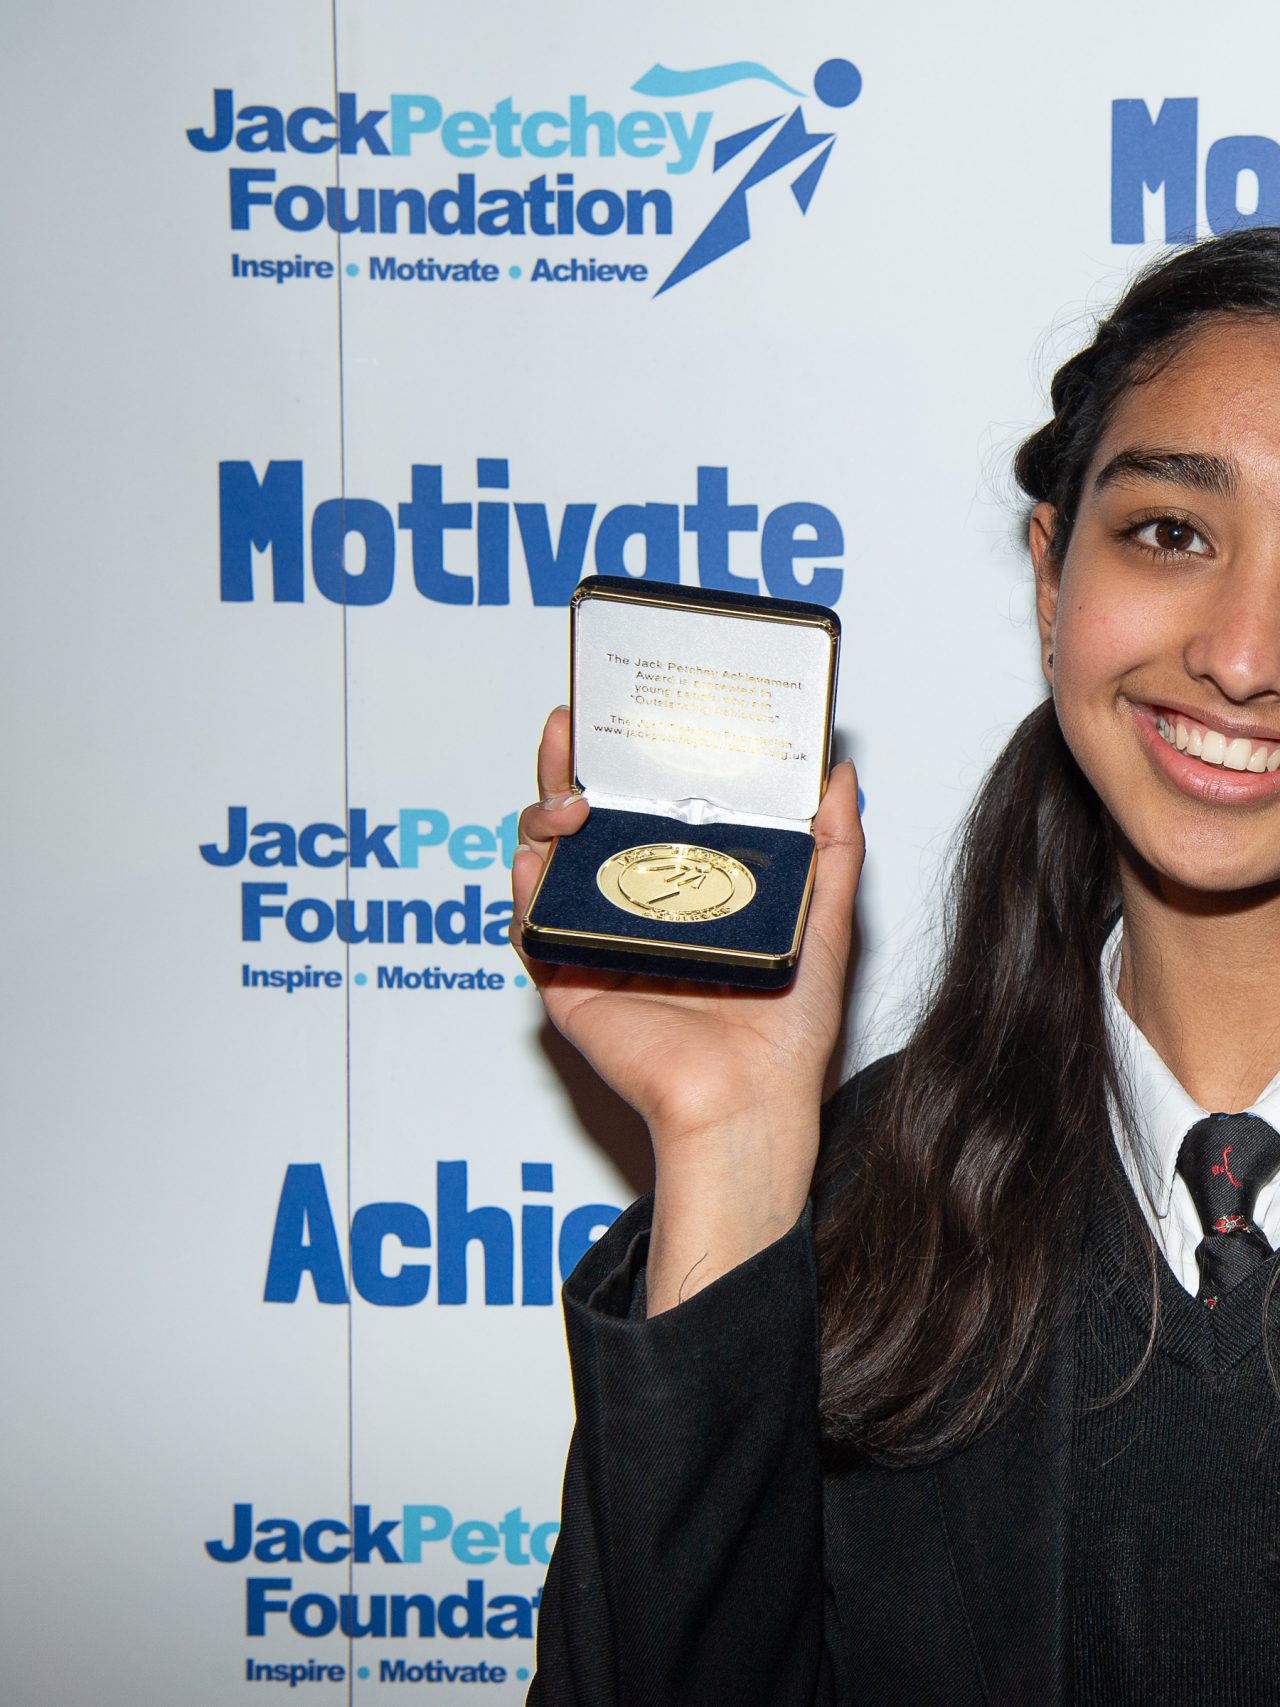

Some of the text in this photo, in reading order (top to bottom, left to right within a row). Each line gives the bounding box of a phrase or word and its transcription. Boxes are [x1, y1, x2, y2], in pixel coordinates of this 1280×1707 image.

[228, 167, 673, 236] Foundation
[231, 252, 648, 284] Inspire Motivate Achieve
[218, 457, 844, 608] Motivate
[606, 652, 630, 666] The
[634, 657, 663, 670] Jack
[668, 662, 718, 679] Petchey
[635, 670, 673, 684] Award
[635, 684, 671, 698] young
[609, 714, 632, 727] The
[198, 806, 519, 870] JackPet
[241, 881, 513, 946] Founda
[242, 964, 505, 993] Inspire Motivate
[263, 1159, 627, 1307] Achi
[204, 1503, 562, 1565] JackPetc
[245, 1577, 544, 1639] Founda
[245, 1658, 507, 1687] Inspire Motivate
